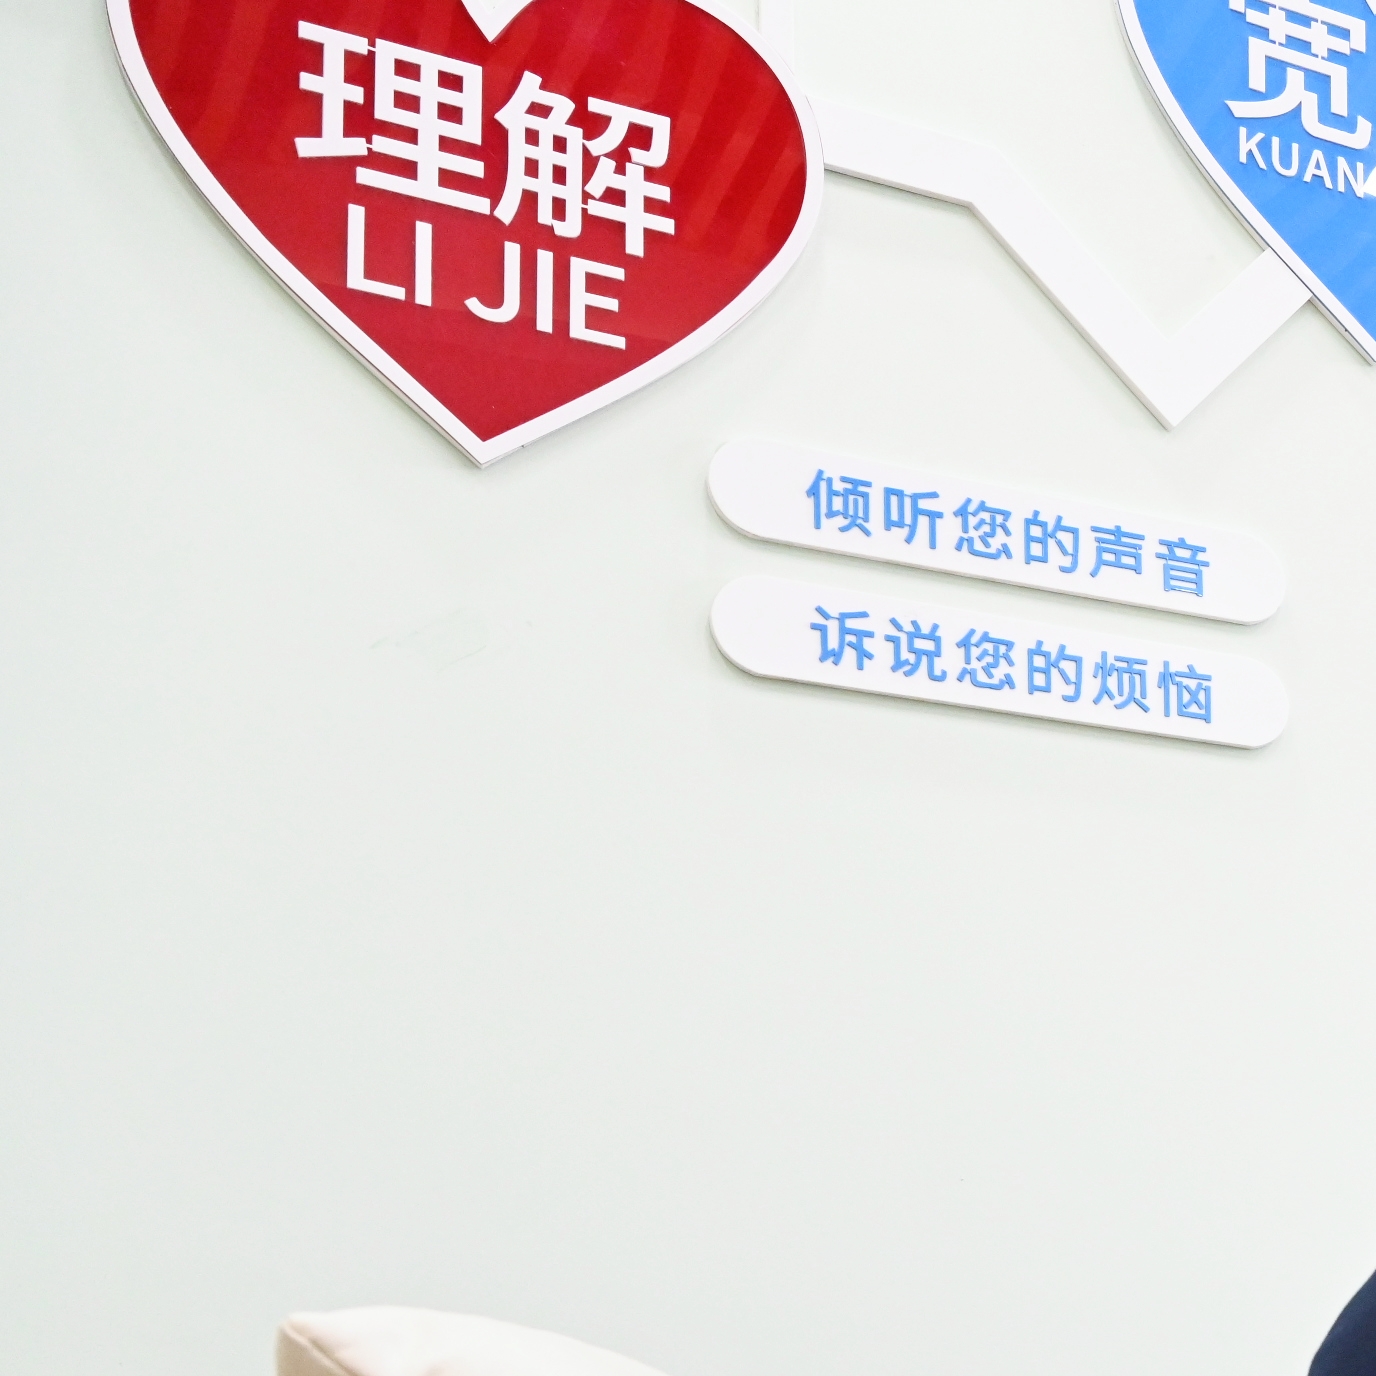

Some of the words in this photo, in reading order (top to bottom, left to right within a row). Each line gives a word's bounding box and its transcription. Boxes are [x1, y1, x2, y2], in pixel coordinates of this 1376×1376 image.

[296, 20, 675, 258] 理解
[1239, 126, 1365, 198] KUAN
[346, 203, 432, 306] LI
[465, 241, 627, 350] JIE
[805, 468, 1210, 598] 倾听您的声音
[809, 605, 1214, 725] 诉说您的烦恼
